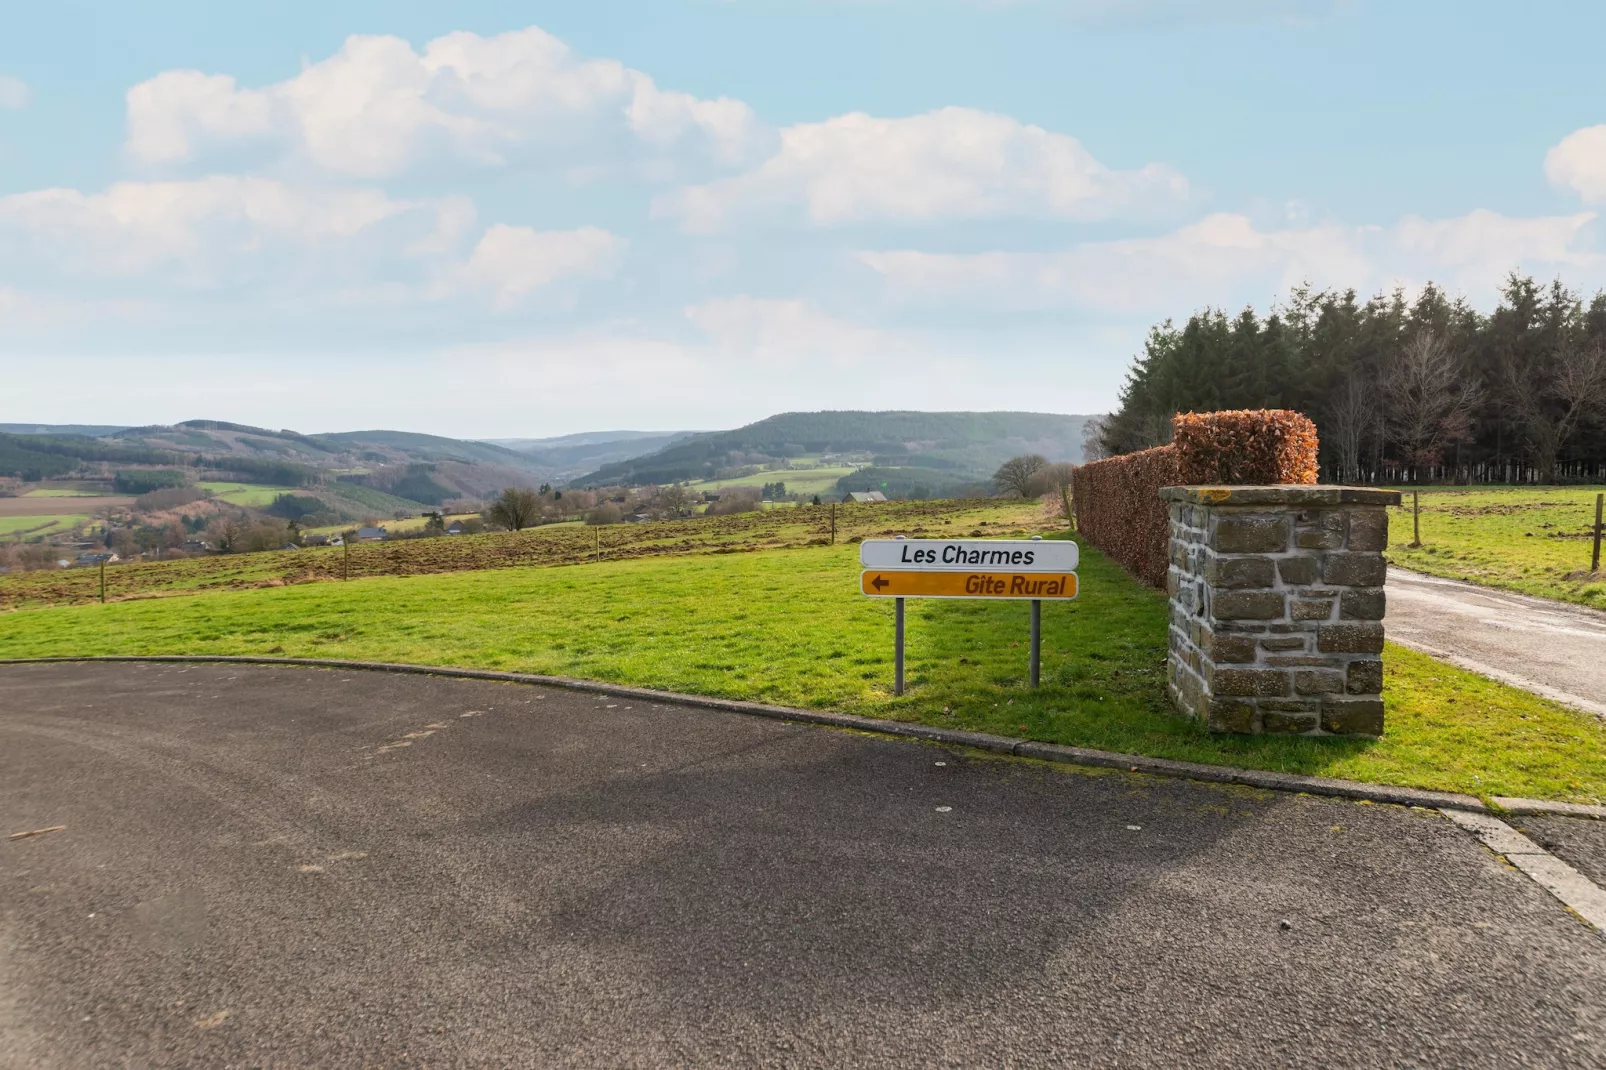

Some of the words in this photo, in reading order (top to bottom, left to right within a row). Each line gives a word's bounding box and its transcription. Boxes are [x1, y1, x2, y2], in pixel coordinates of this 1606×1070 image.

[901, 545, 936, 563] Les
[942, 545, 1035, 565] Charmes
[965, 575, 1005, 594] Gîte
[1010, 576, 1066, 595] Rural
